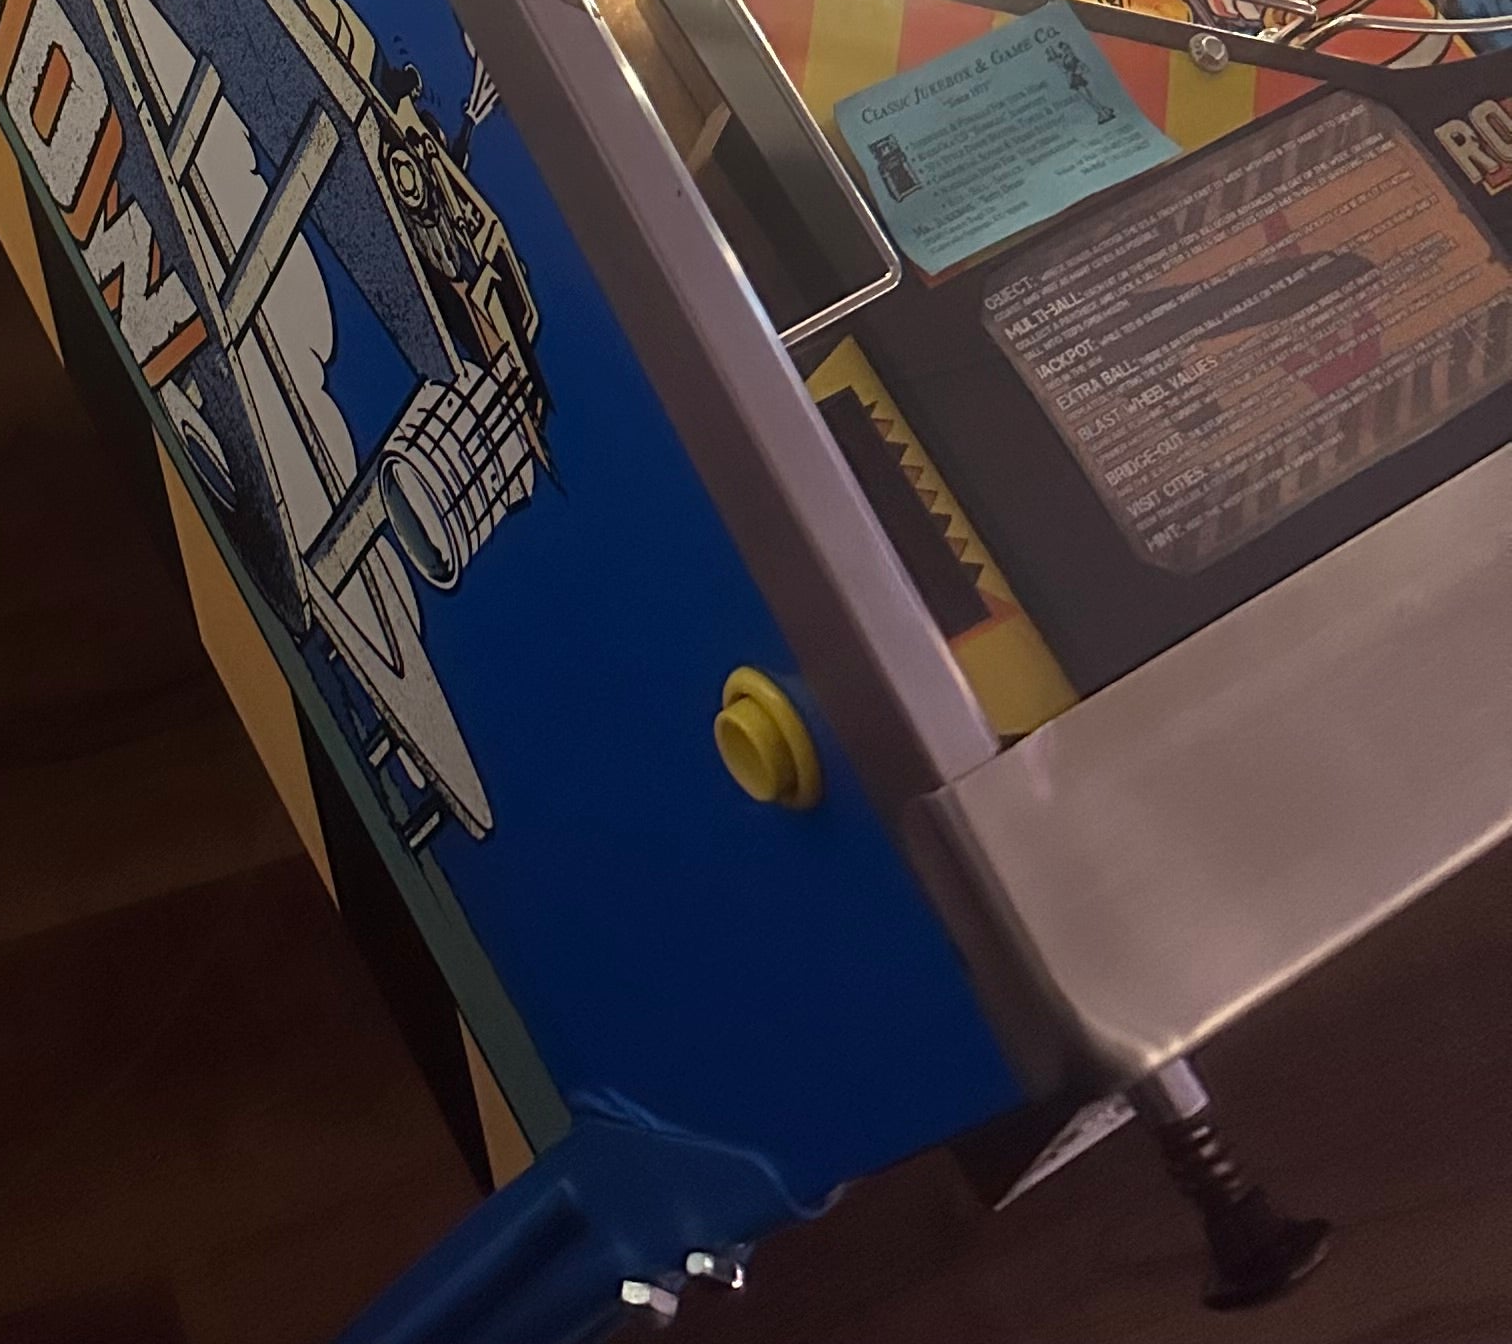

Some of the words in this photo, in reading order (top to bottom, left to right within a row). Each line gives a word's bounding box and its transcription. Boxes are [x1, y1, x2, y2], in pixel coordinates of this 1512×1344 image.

[975, 57, 989, 75] &
[1055, 378, 1104, 411] EXTRA
[1076, 408, 1122, 442] BLAST
[1122, 384, 1171, 419] WHEEL
[1126, 490, 1161, 518] VISIT
